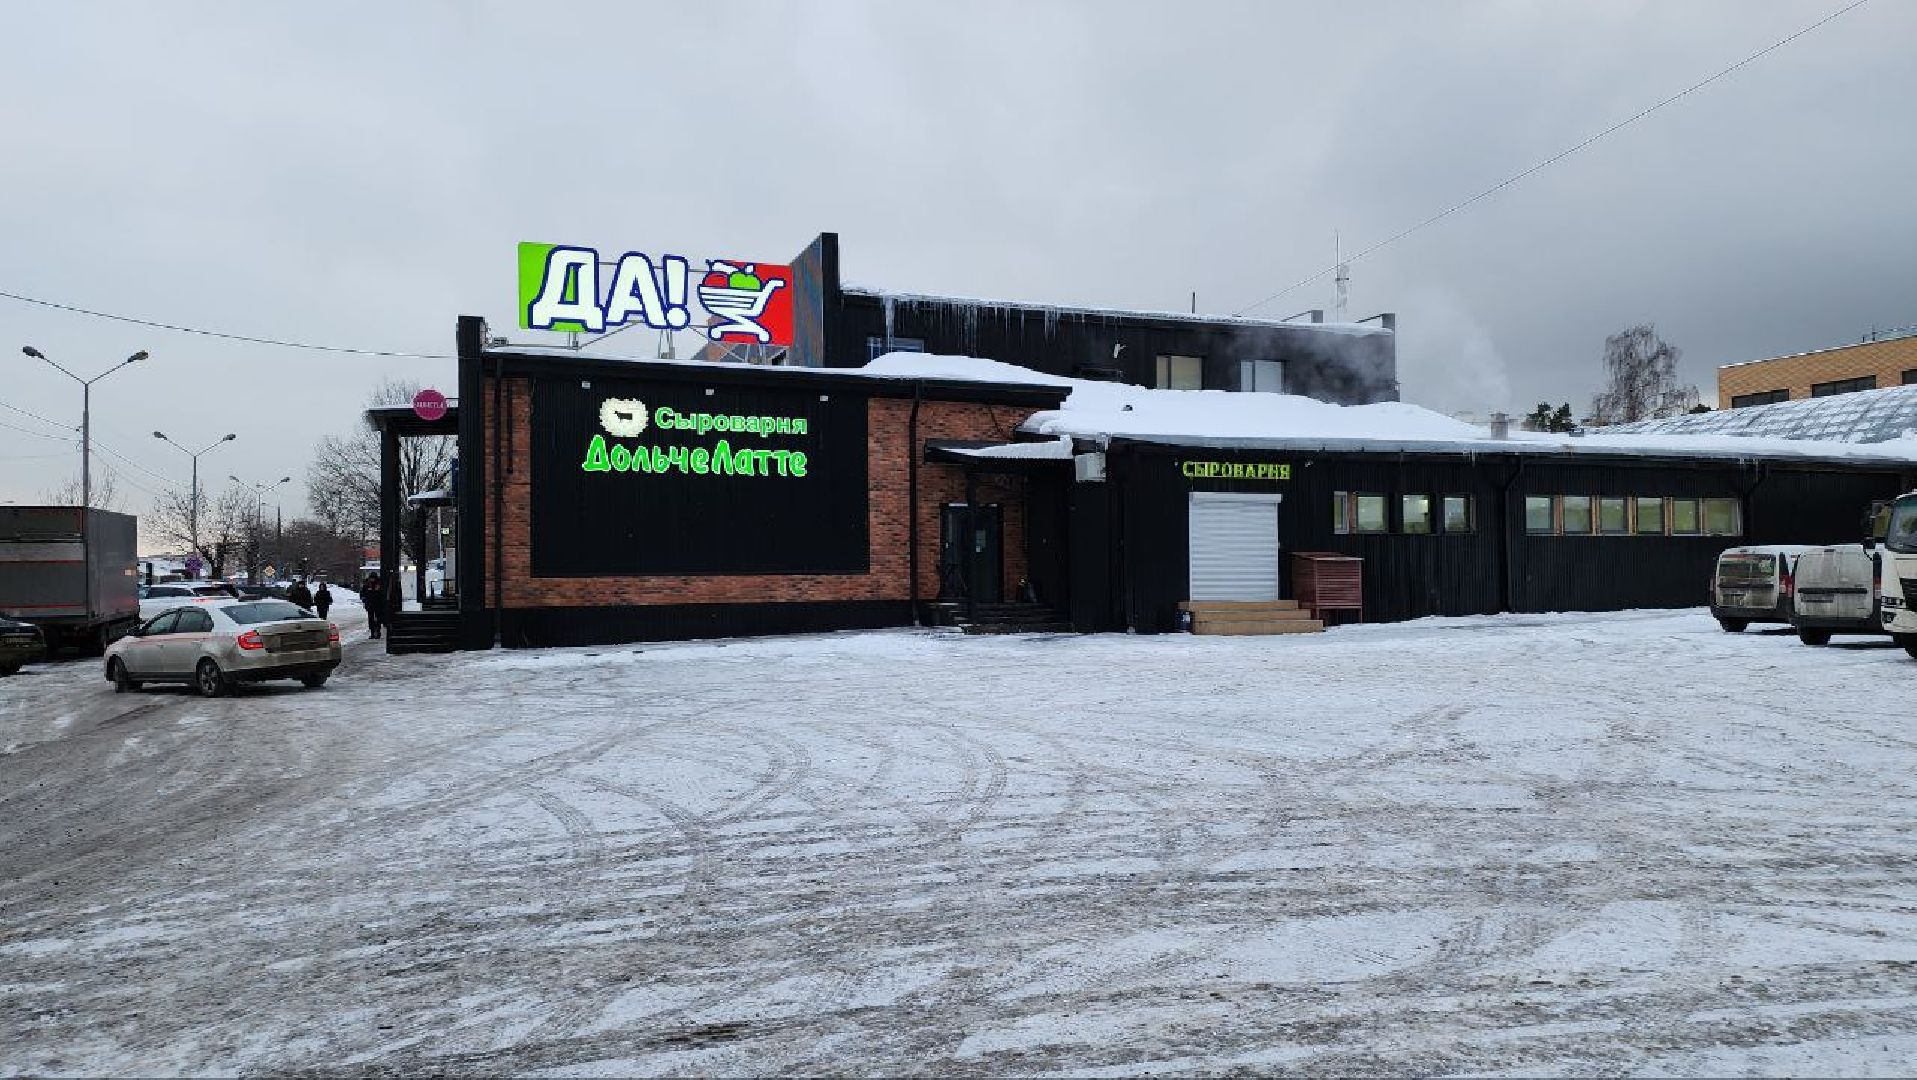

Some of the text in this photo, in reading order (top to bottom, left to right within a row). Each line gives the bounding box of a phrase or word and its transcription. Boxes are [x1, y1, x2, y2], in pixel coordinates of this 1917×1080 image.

[528, 245, 690, 333] ДА!
[655, 407, 807, 437] Сыроварня
[582, 434, 808, 477] ДольчеЛатте
[1182, 461, 1291, 480] СЫРОВАРНЯ
